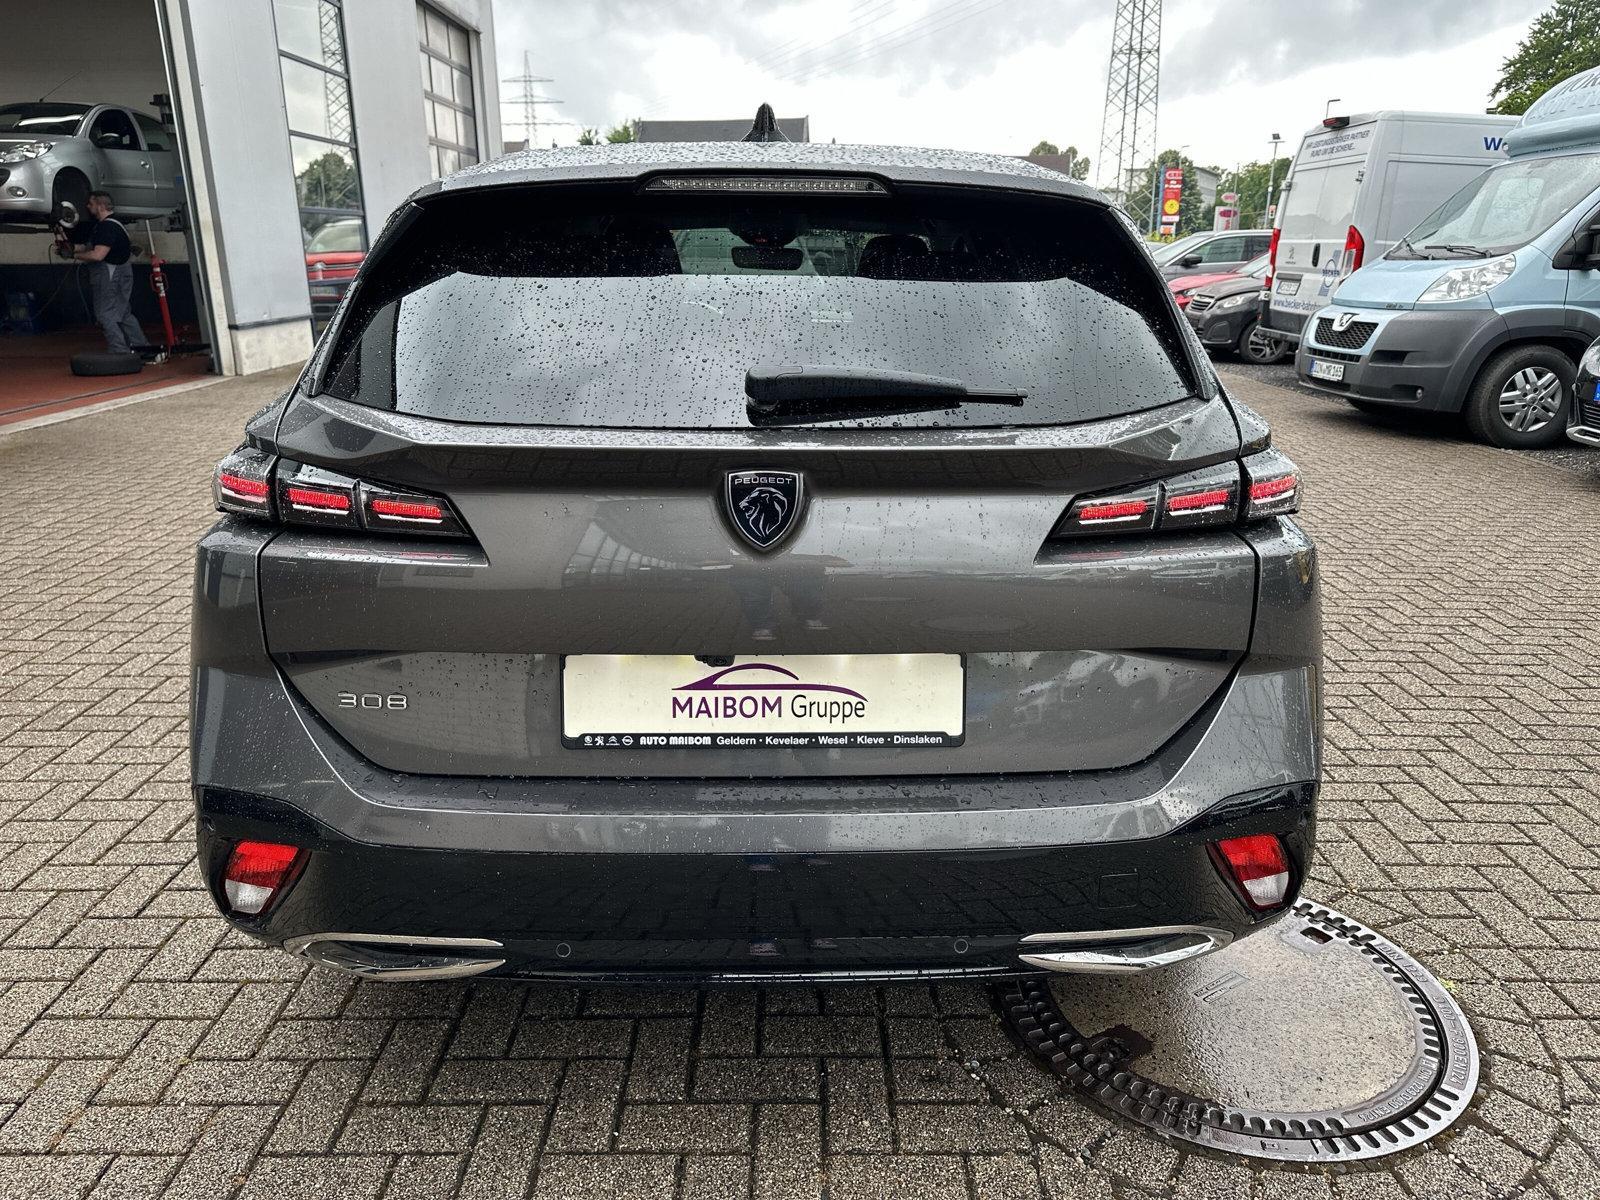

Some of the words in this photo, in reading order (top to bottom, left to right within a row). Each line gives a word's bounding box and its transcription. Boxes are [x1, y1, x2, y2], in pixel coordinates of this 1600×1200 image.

[1483, 137, 1503, 151] W
[734, 476, 793, 485] PEUGEOT
[337, 692, 409, 710] 308
[672, 695, 782, 719] MAIBOM
[791, 694, 866, 724] Gruppe
[640, 735, 667, 746] AUTO
[669, 735, 711, 746] MAIBOM
[716, 735, 757, 746] Geldern
[765, 735, 809, 745] Kevelaer
[818, 735, 848, 745] Wesel
[857, 734, 884, 745] Kleve
[893, 734, 943, 744] Dinslaken
